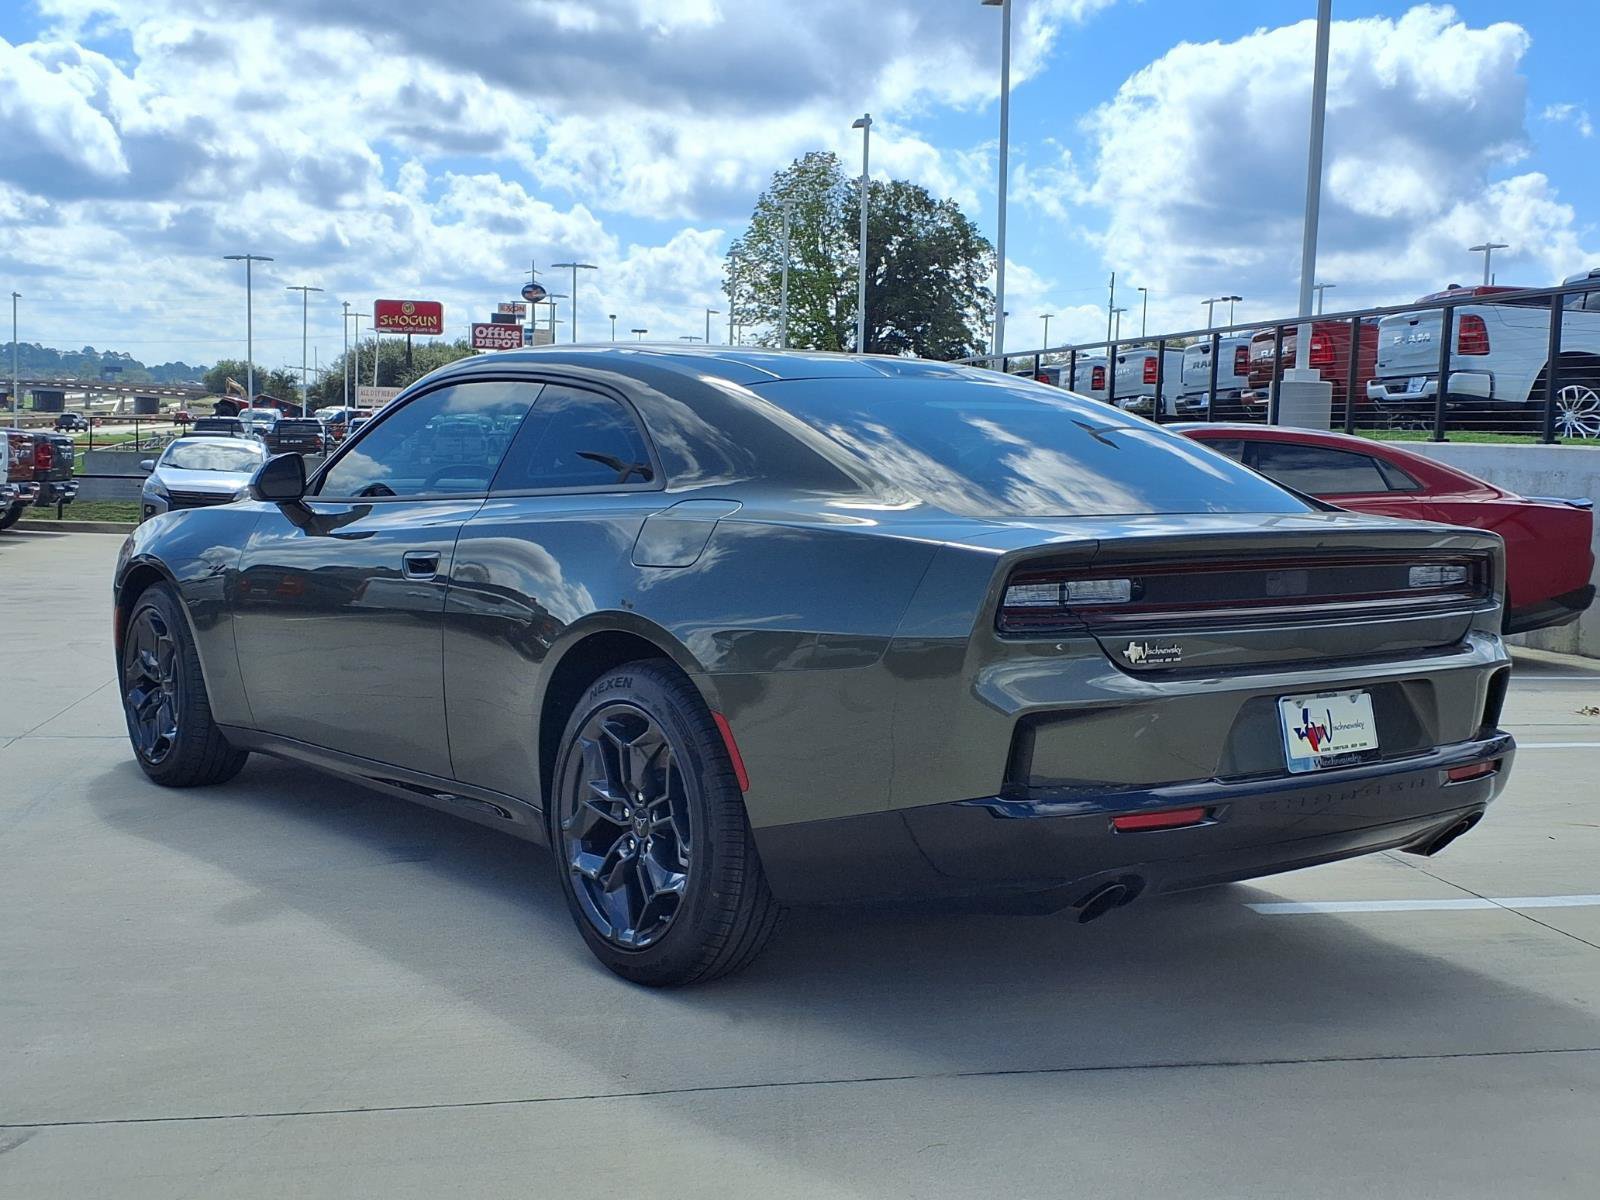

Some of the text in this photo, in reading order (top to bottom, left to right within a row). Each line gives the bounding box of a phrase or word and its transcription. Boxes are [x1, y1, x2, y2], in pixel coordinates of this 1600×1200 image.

[379, 314, 438, 327] SHOGUN
[475, 326, 521, 339] Office
[475, 338, 520, 348] DEPOT
[1192, 360, 1211, 369] RA
[589, 676, 634, 701] NEXEN
